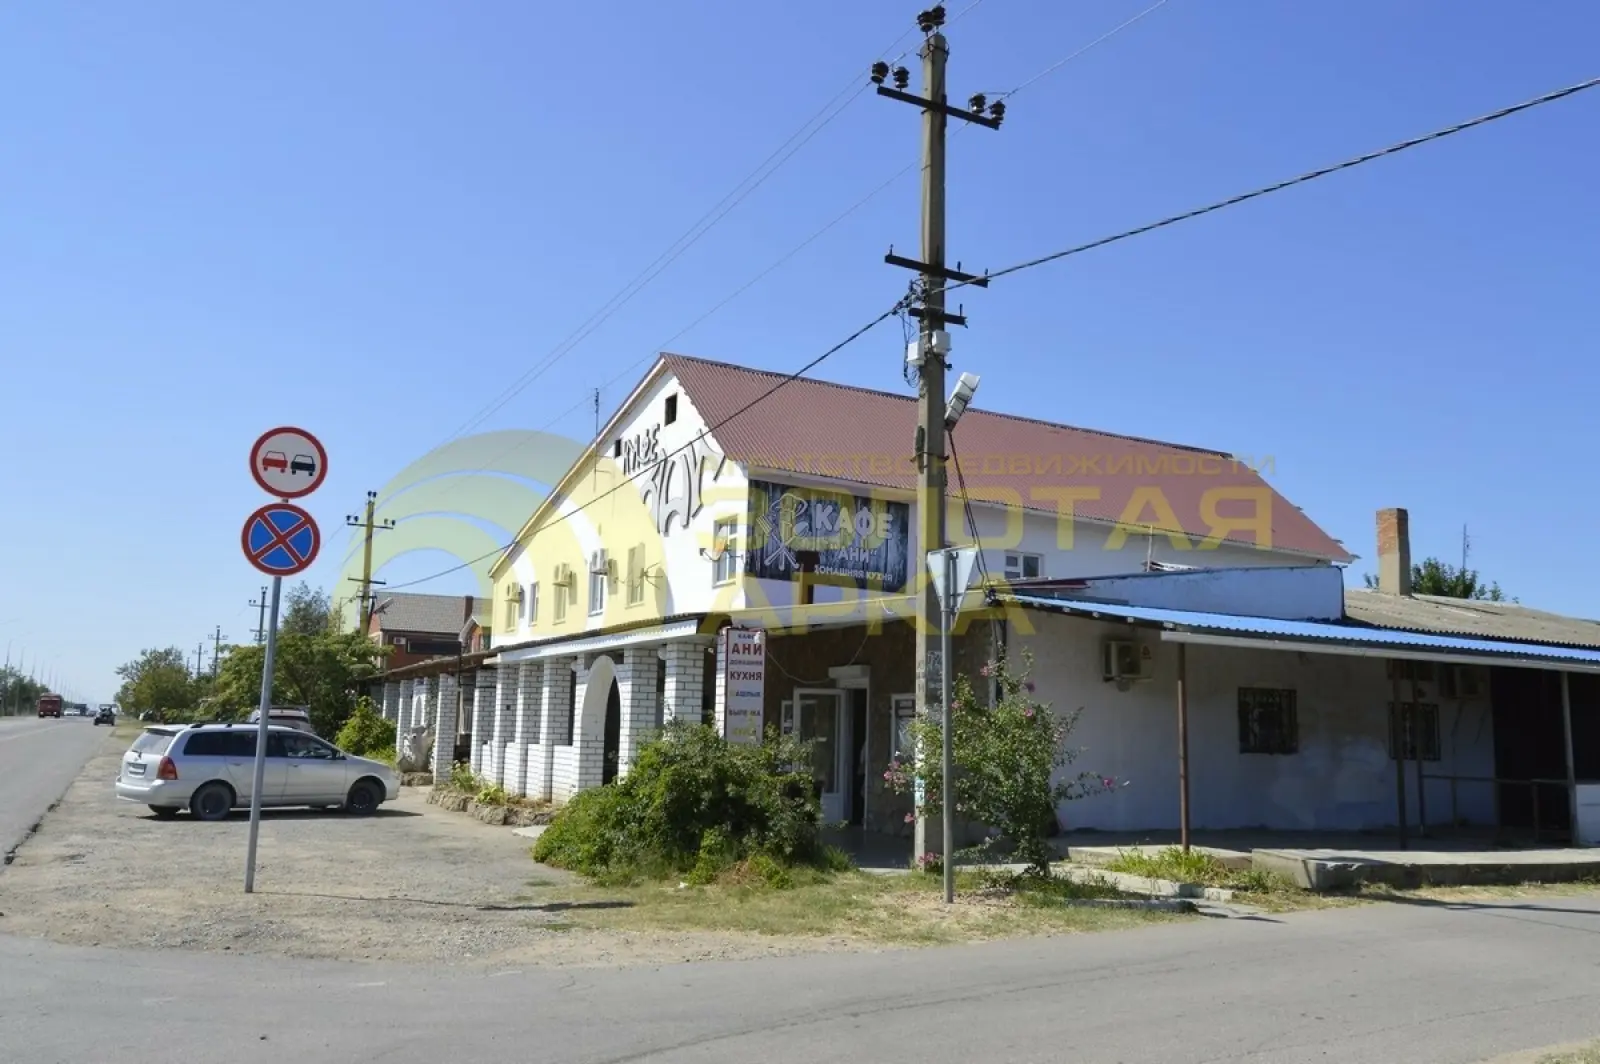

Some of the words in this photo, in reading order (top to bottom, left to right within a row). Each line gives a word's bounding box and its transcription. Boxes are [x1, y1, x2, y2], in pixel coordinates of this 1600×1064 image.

[815, 503, 893, 546] КАФЕ
[731, 643, 762, 655] АНИ
[730, 671, 762, 681] КУХНЯ
